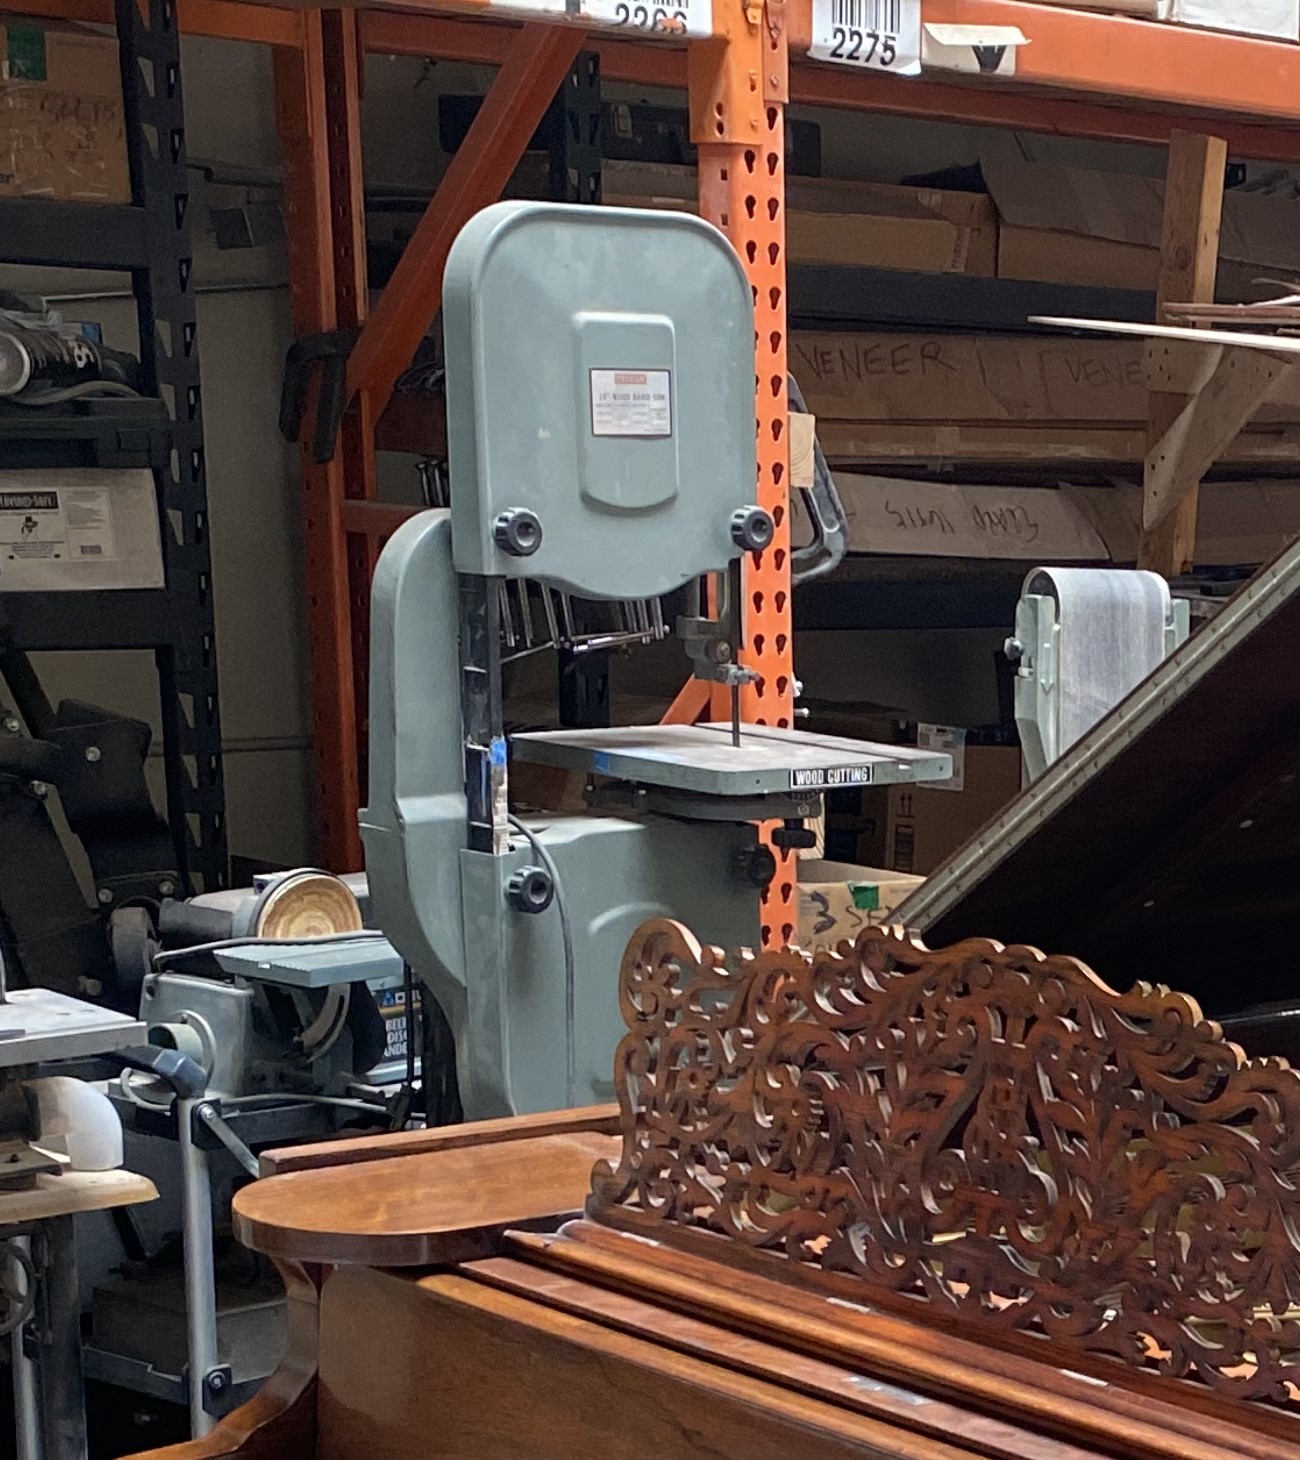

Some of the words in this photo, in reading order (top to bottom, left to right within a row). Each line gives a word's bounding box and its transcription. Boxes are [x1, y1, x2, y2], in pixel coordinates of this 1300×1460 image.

[829, 27, 897, 66] 2275
[795, 340, 957, 384] VENEER
[1063, 354, 1144, 386] VENE
[795, 769, 824, 785] WOOD
[827, 767, 868, 784] CUTTING
